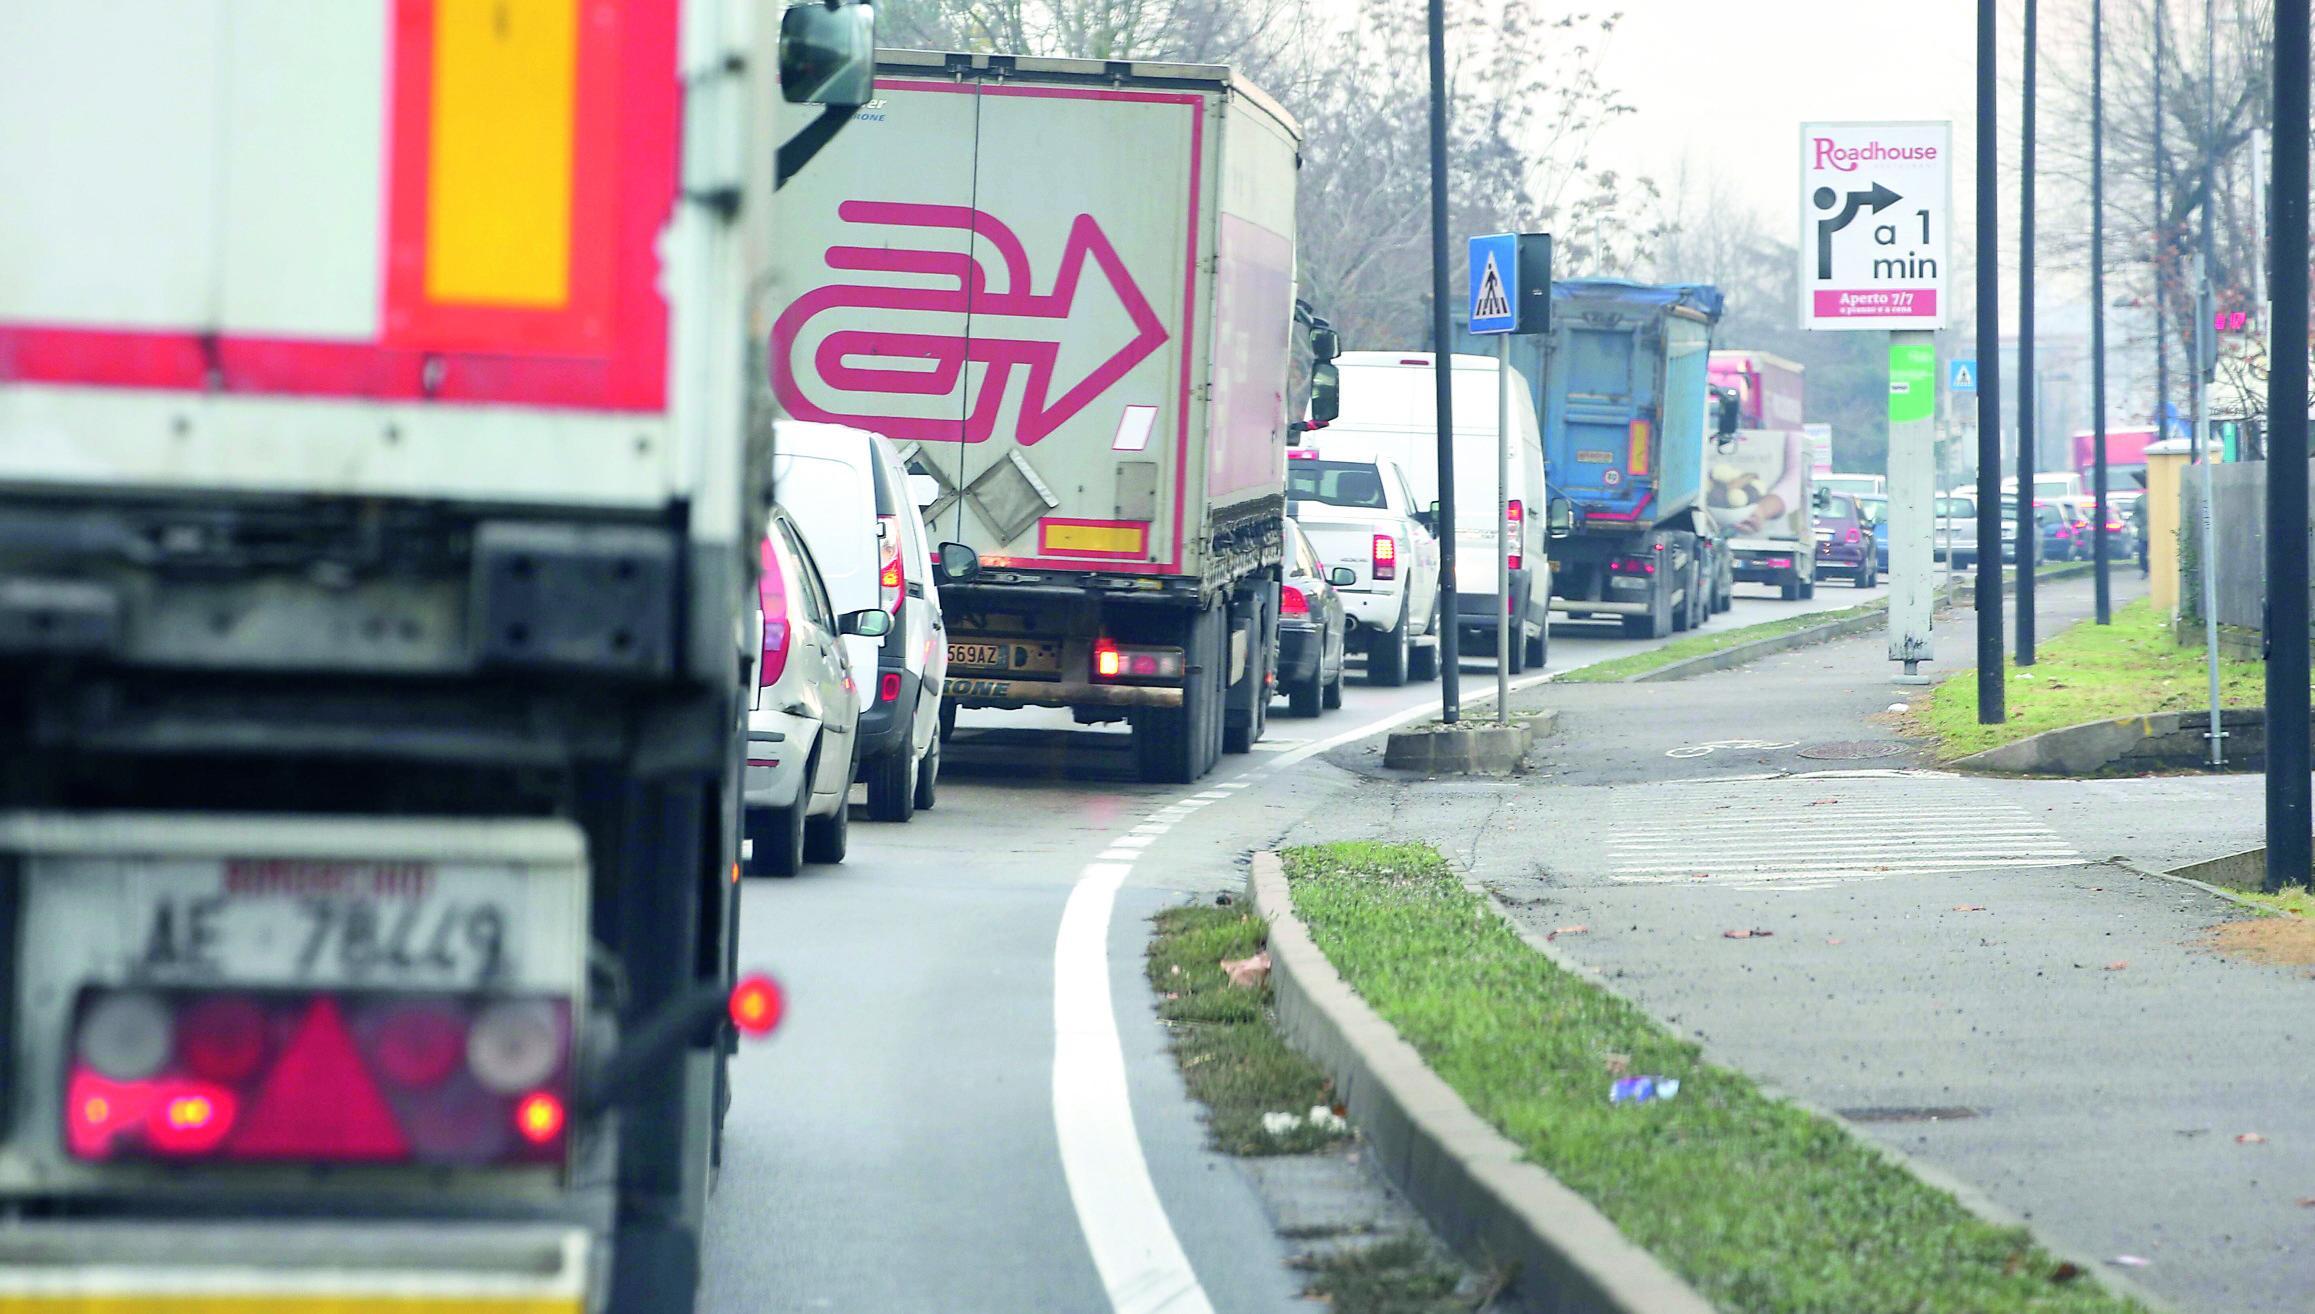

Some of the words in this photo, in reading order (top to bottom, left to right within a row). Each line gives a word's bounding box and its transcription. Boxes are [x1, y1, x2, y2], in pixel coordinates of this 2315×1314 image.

[853, 113, 886, 122] RONE
[1813, 138, 1937, 172] Roadhouse
[1874, 225, 1896, 245] a
[1916, 209, 1930, 245] 1
[1873, 250, 1937, 279] min
[1840, 292, 1889, 307] Aperto
[1891, 291, 1914, 306] 7/7
[947, 645, 997, 664] 569AZ
[943, 680, 1011, 697] RONE
